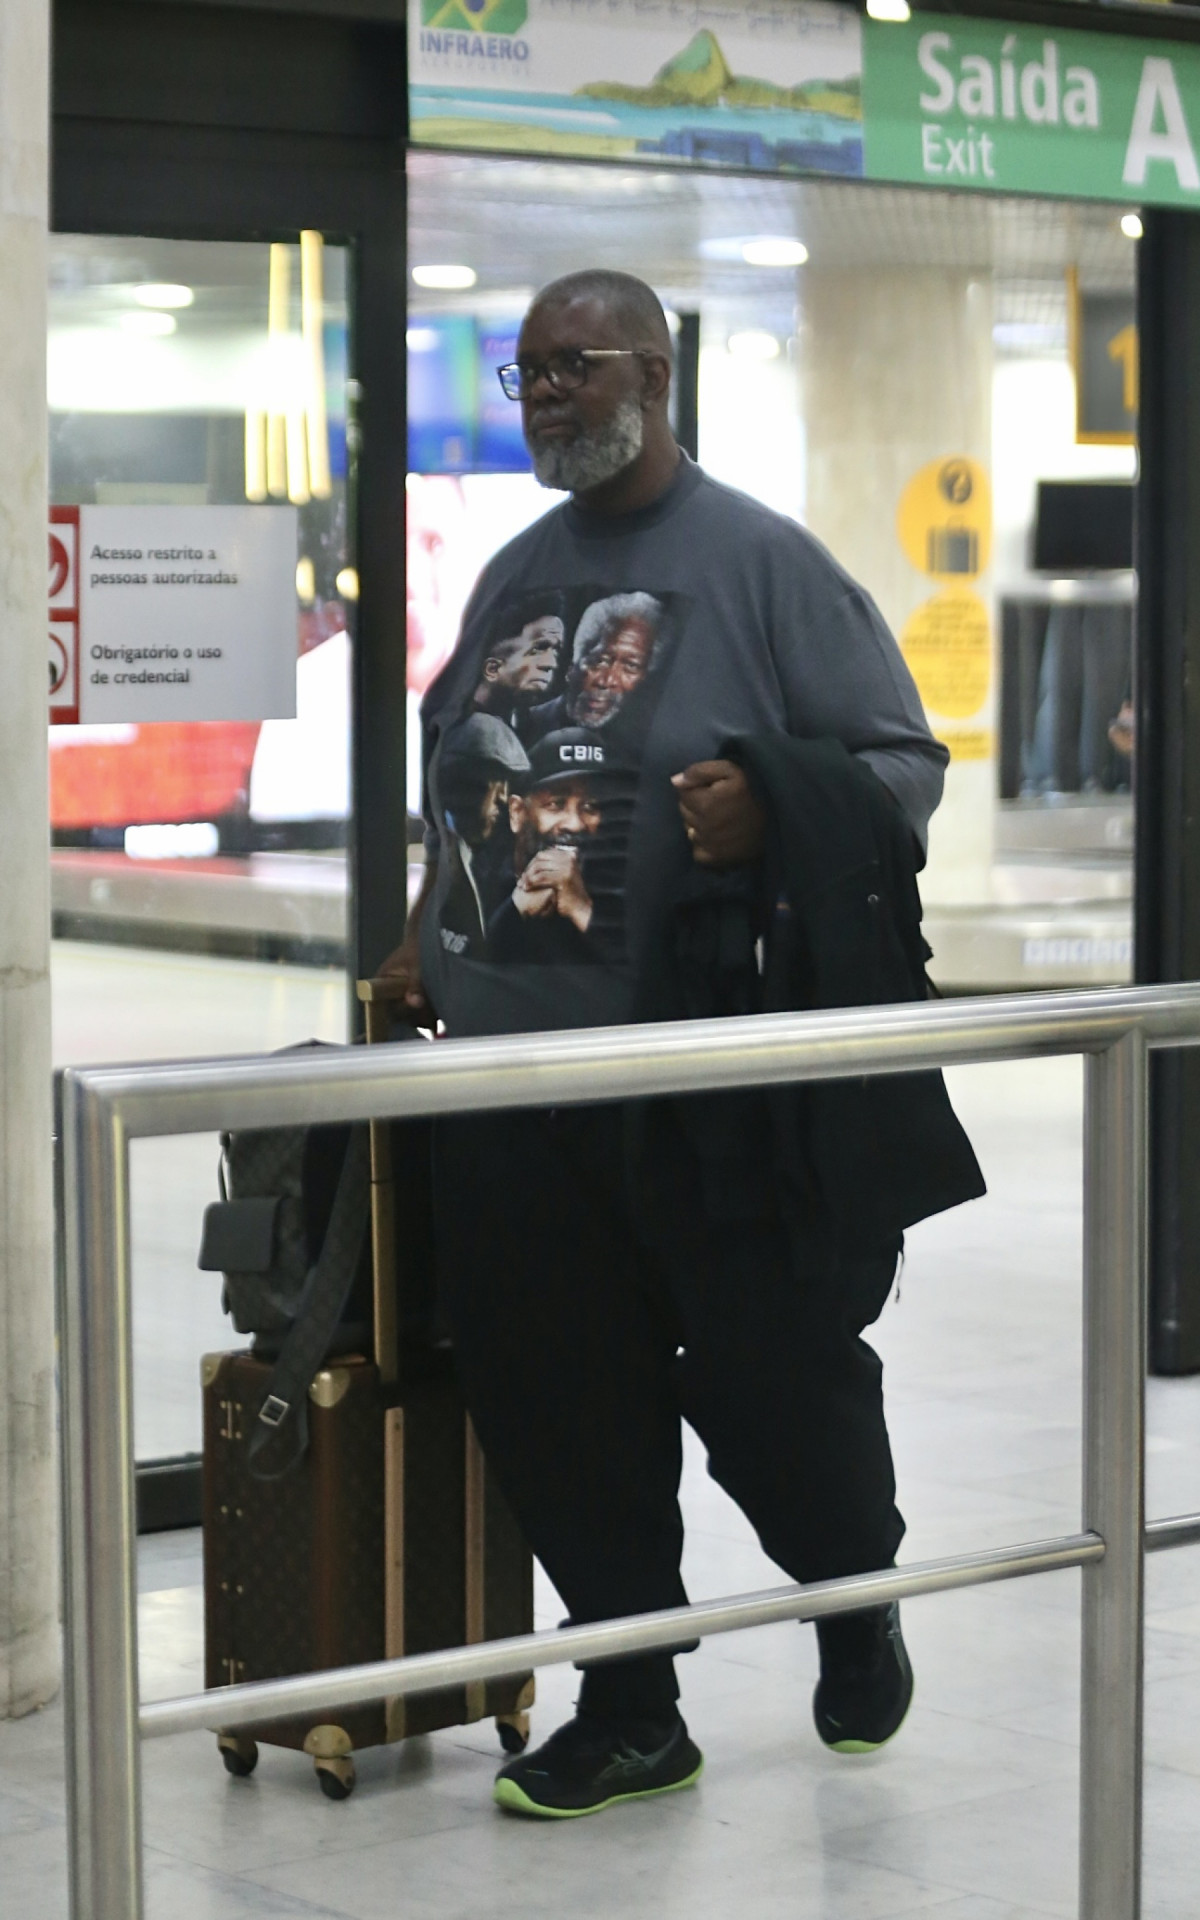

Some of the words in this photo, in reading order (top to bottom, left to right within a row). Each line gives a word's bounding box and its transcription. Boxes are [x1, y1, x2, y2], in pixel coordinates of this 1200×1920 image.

[419, 31, 529, 61] INFRAERO
[917, 31, 1099, 129] Saída
[1122, 55, 1200, 190] A
[921, 123, 995, 178] Exit
[91, 546, 142, 560] Acesso
[147, 545, 204, 560] restrito
[208, 550, 216, 560] a
[90, 572, 147, 588] pessoas
[153, 570, 238, 585] autorizadas
[90, 644, 178, 663] Obrigatório
[183, 648, 192, 658] o
[197, 647, 222, 659] uso
[91, 670, 108, 684] de
[114, 669, 190, 684] credencial
